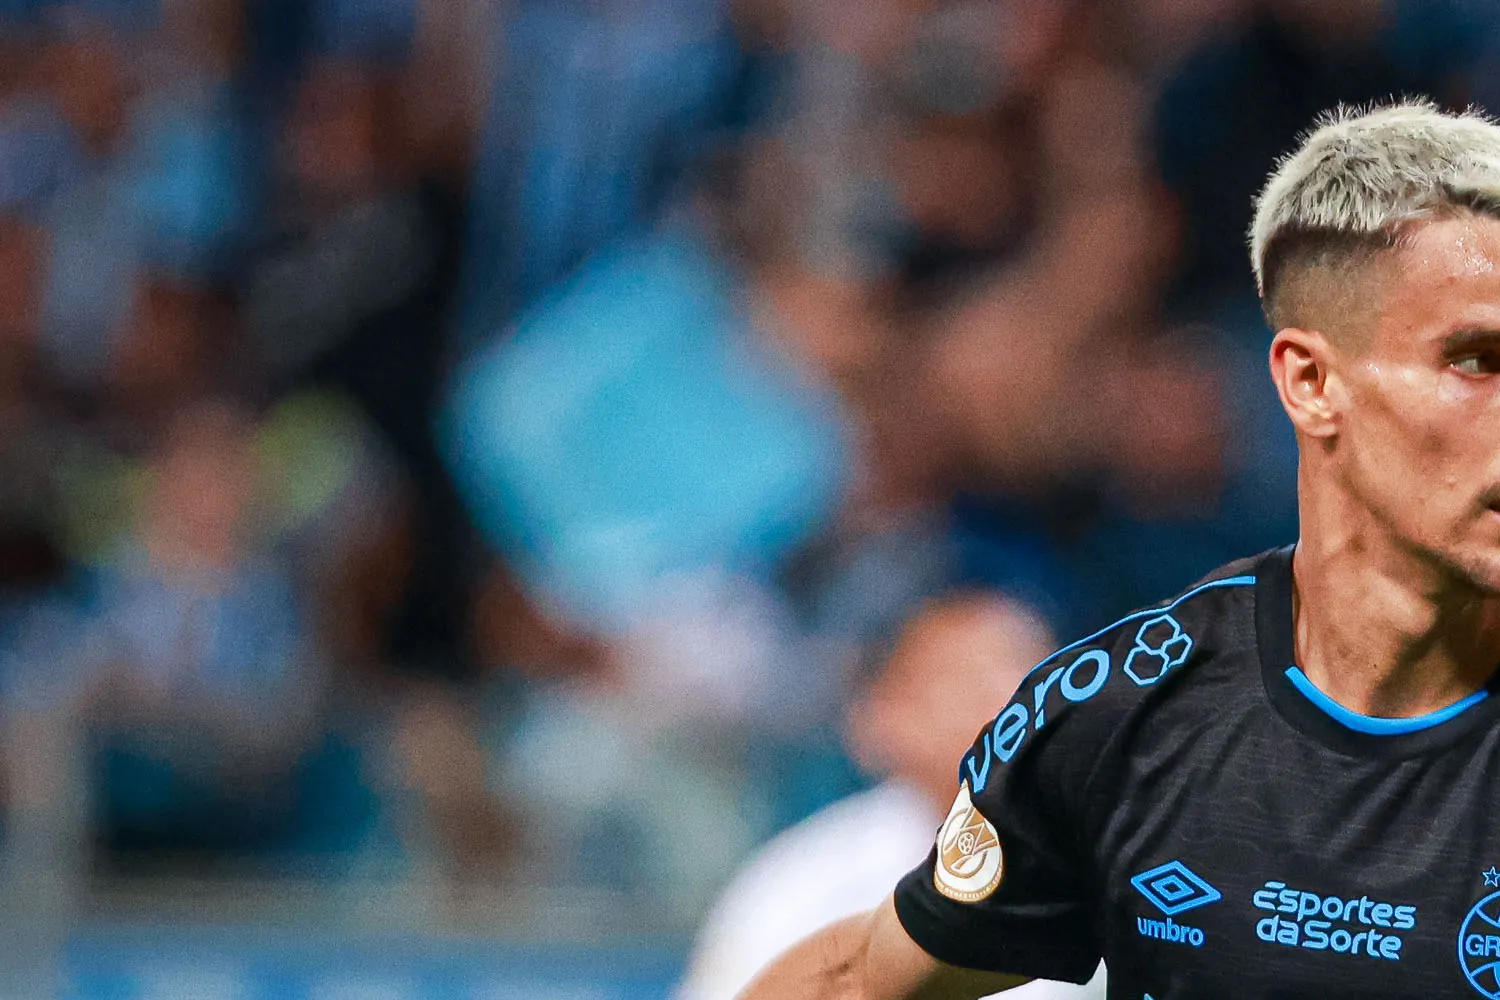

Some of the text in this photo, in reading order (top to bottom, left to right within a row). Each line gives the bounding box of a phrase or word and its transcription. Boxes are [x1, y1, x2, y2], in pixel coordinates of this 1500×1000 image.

[967, 649, 1111, 794] vero
[1253, 881, 1417, 930] Esportes
[1137, 916, 1204, 946] umbro
